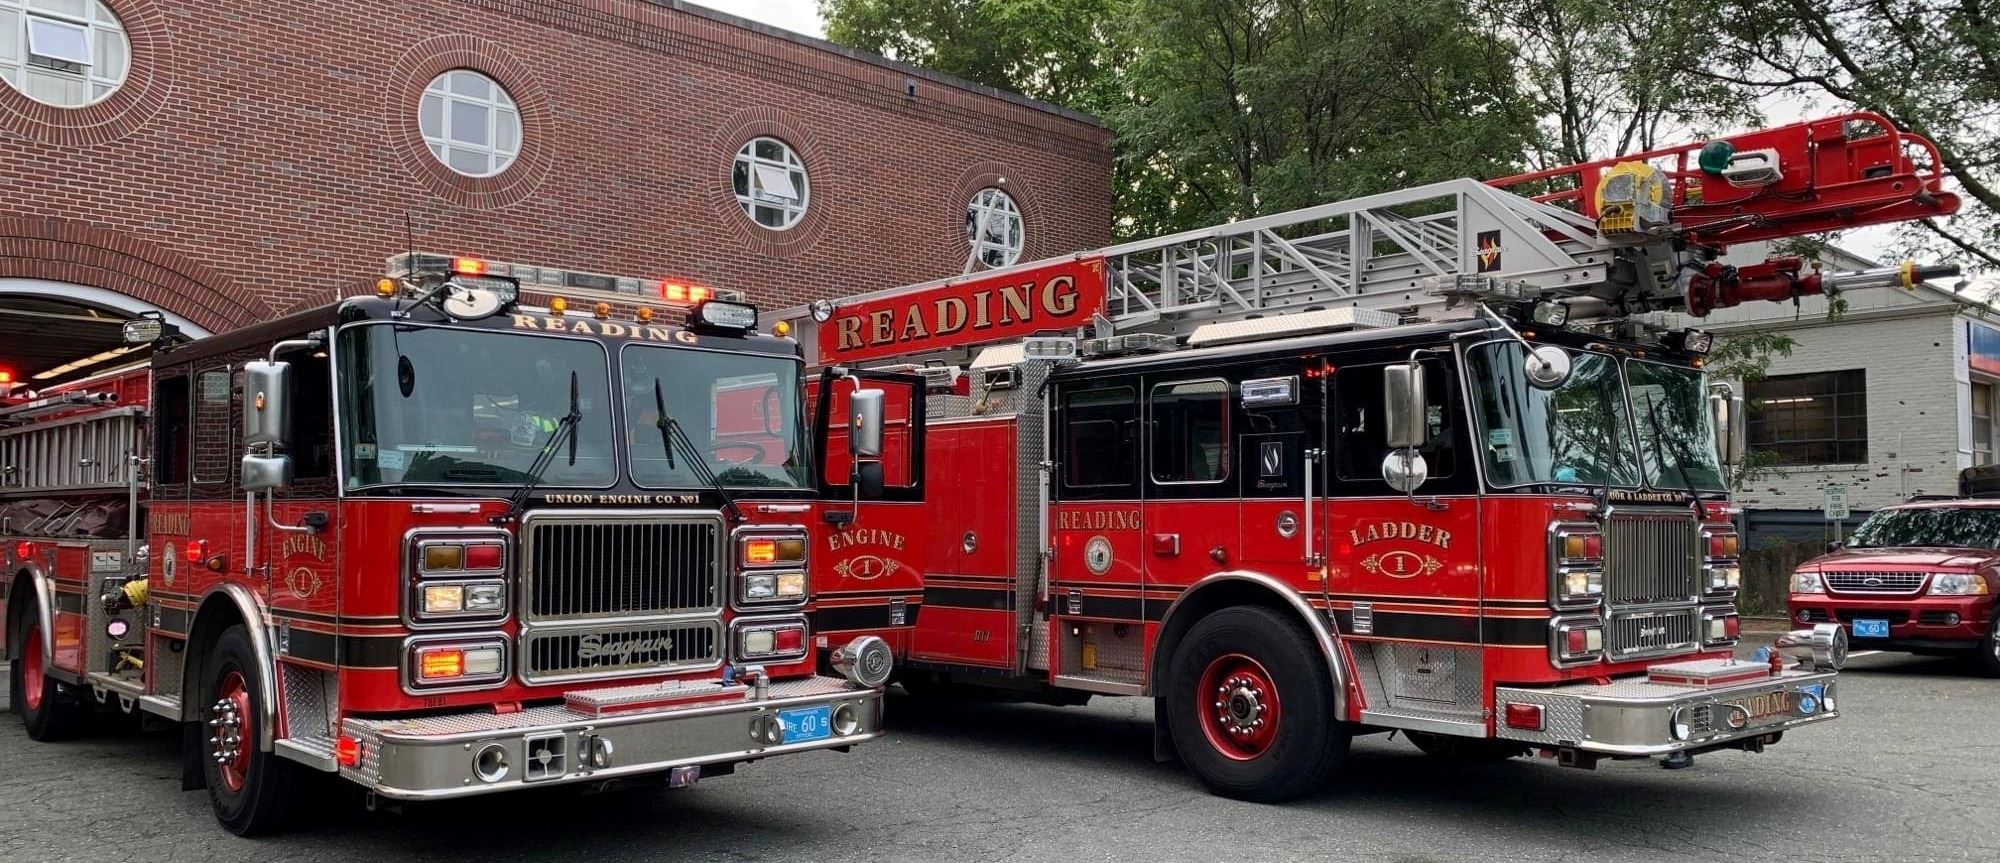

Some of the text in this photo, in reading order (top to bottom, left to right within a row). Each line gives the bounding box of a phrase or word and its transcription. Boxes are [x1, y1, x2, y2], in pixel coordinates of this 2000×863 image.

[836, 275, 1079, 351] READING
[512, 314, 698, 345] READING
[545, 494, 593, 504] UNION
[600, 494, 651, 504] ENGINE
[655, 494, 677, 504] CO.
[152, 513, 189, 536] READING
[1059, 510, 1141, 530] READING
[827, 528, 905, 551] ENGINE
[1349, 521, 1451, 549] LADDER
[283, 534, 327, 563] ENGINE
[863, 559, 871, 574] 1
[1395, 555, 1406, 572] 1
[300, 572, 306, 591] 1
[577, 634, 673, 665] Seagrave
[785, 714, 828, 734] IRE 60 S
